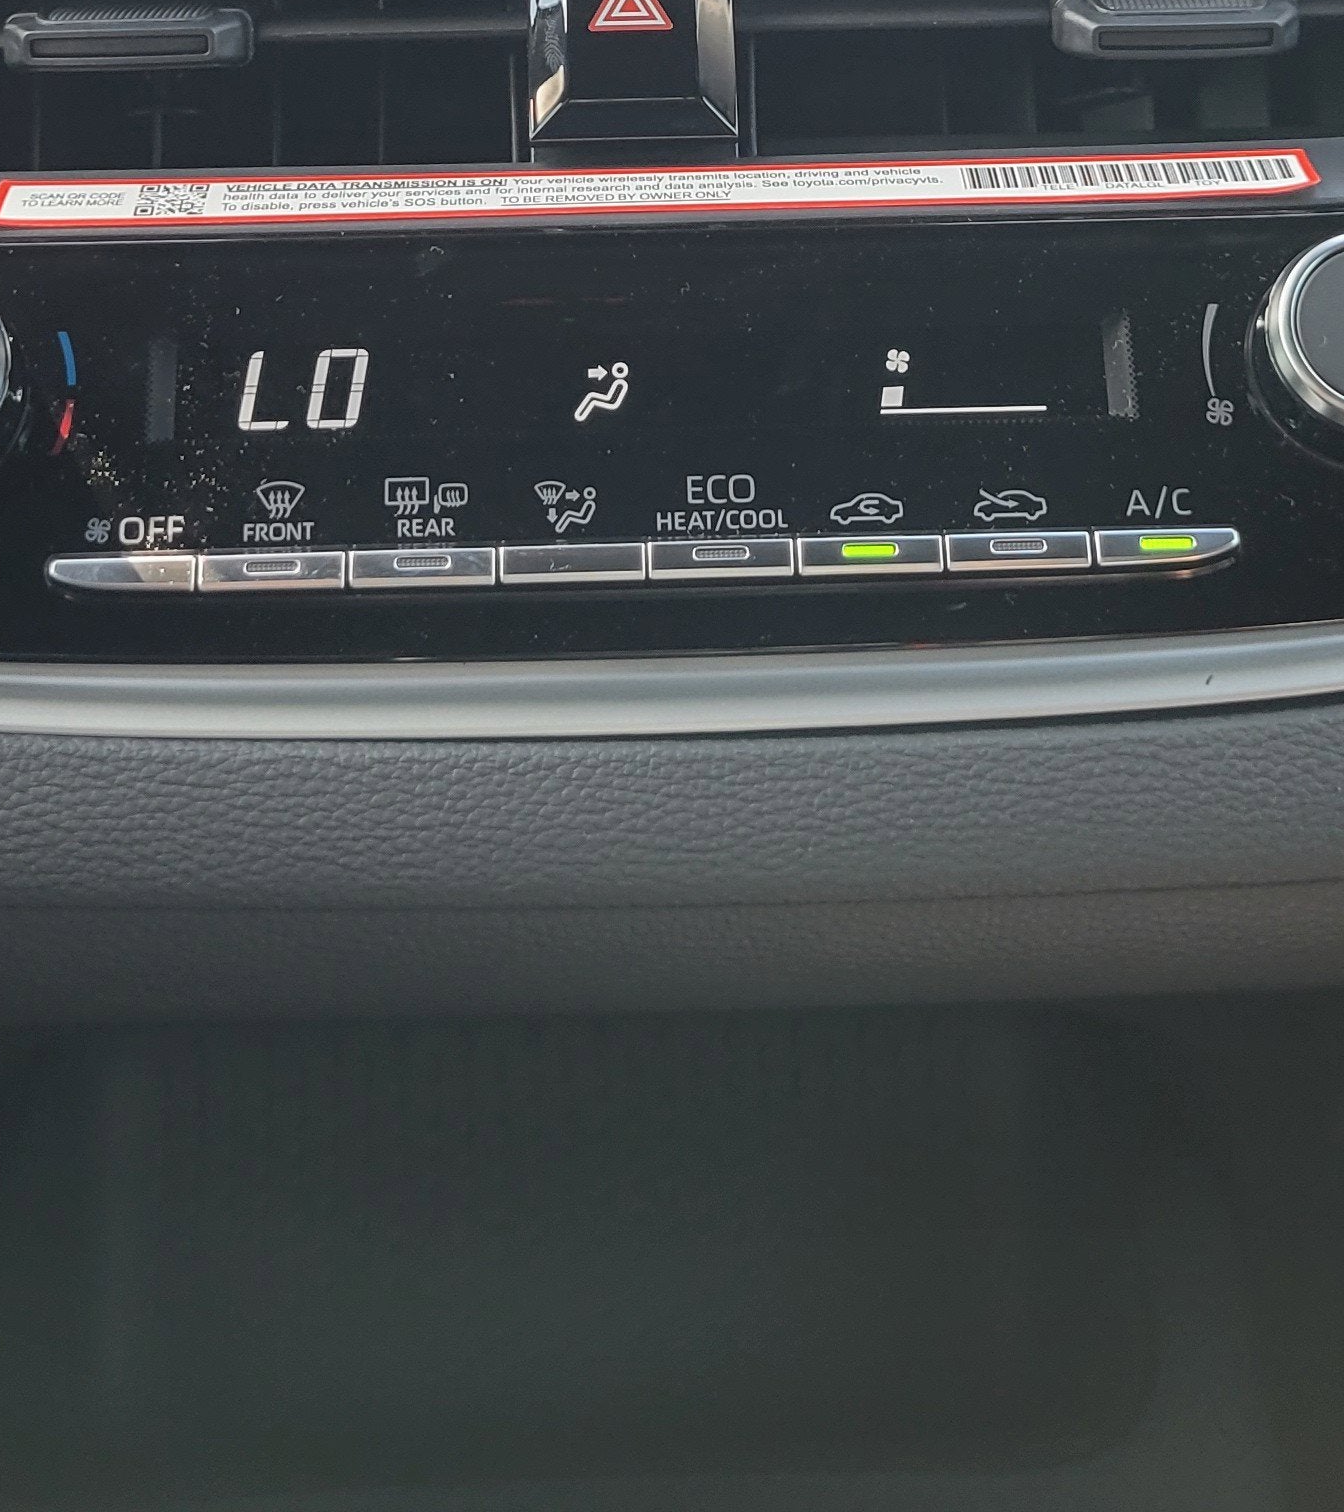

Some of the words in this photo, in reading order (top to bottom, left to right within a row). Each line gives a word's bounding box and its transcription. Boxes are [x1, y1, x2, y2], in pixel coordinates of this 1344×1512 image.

[223, 191, 265, 201] health
[269, 191, 300, 200] data
[304, 190, 318, 199] to
[321, 189, 368, 199] deliver
[371, 190, 400, 199] your
[405, 188, 461, 197] services
[465, 186, 490, 195] and
[494, 185, 513, 194] for
[517, 184, 567, 194] internal
[571, 182, 631, 192] research
[635, 181, 660, 191] and
[664, 181, 694, 190] data
[698, 179, 757, 190] analysis.
[761, 178, 789, 188] See
[226, 183, 295, 192] VEHICLE
[297, 182, 337, 191] DATA
[341, 179, 458, 190] TRANSMISSION
[462, 179, 476, 188] IS
[513, 178, 543, 186] Your
[547, 176, 594, 185] vehicle
[599, 174, 664, 185] wirelessly
[668, 173, 731, 182] transmits
[733, 170, 791, 180] location,
[794, 169, 839, 179] driving
[844, 168, 869, 177] and
[873, 167, 921, 176] vehicle
[1040, 183, 1074, 191] TELE
[1194, 179, 1222, 187] TOY
[40, 199, 84, 207] LEARN
[86, 198, 124, 206] MORE
[89, 191, 126, 199] CODE
[221, 202, 238, 211] To
[241, 201, 294, 212] disable,
[299, 201, 337, 211] press
[341, 198, 400, 208] vehicle's
[404, 197, 436, 207] SOS
[441, 196, 487, 206] button.
[500, 196, 520, 206] TO
[523, 195, 543, 205] BE
[546, 193, 615, 204] REMOVED
[618, 192, 637, 202] BY
[640, 191, 692, 202] OWNER
[695, 190, 732, 200] ONLY
[238, 348, 369, 431] LO
[685, 473, 757, 505] ECO
[1126, 484, 1193, 519] A/C
[118, 516, 186, 545] OFF
[242, 521, 315, 542] FRONT
[397, 518, 457, 538] REAR
[656, 509, 788, 532] HEAT/COOL
